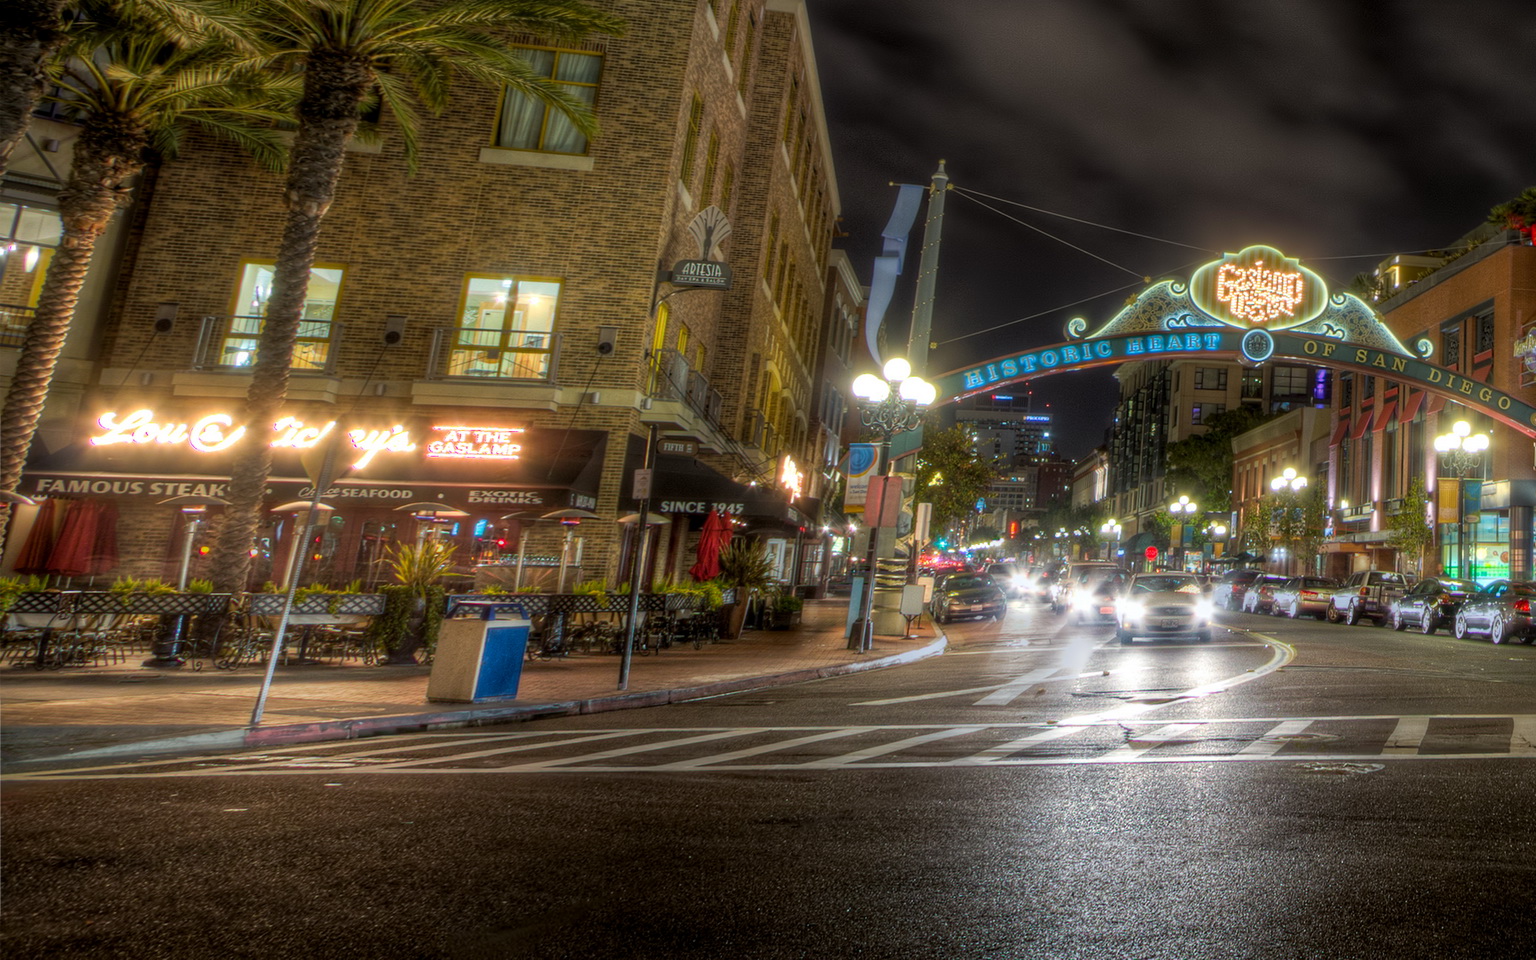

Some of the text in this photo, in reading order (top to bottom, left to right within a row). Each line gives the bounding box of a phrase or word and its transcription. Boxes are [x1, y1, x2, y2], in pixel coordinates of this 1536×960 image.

[682, 262, 722, 277] ARTESIA
[1217, 261, 1303, 304] Gaslamp
[965, 333, 1220, 388] HISTORIC HEART
[1304, 340, 1511, 410] OF SAN DIEGO
[90, 409, 189, 445] Lou
[445, 431, 511, 443] AT THE
[428, 441, 521, 455] GASLAMP
[663, 442, 685, 452] FIFTH
[36, 479, 232, 496] FAMOUS STEAK
[341, 489, 413, 499] SEAFOOD
[469, 490, 540, 498] EXOTIC
[661, 501, 745, 515] SINCE 1945
